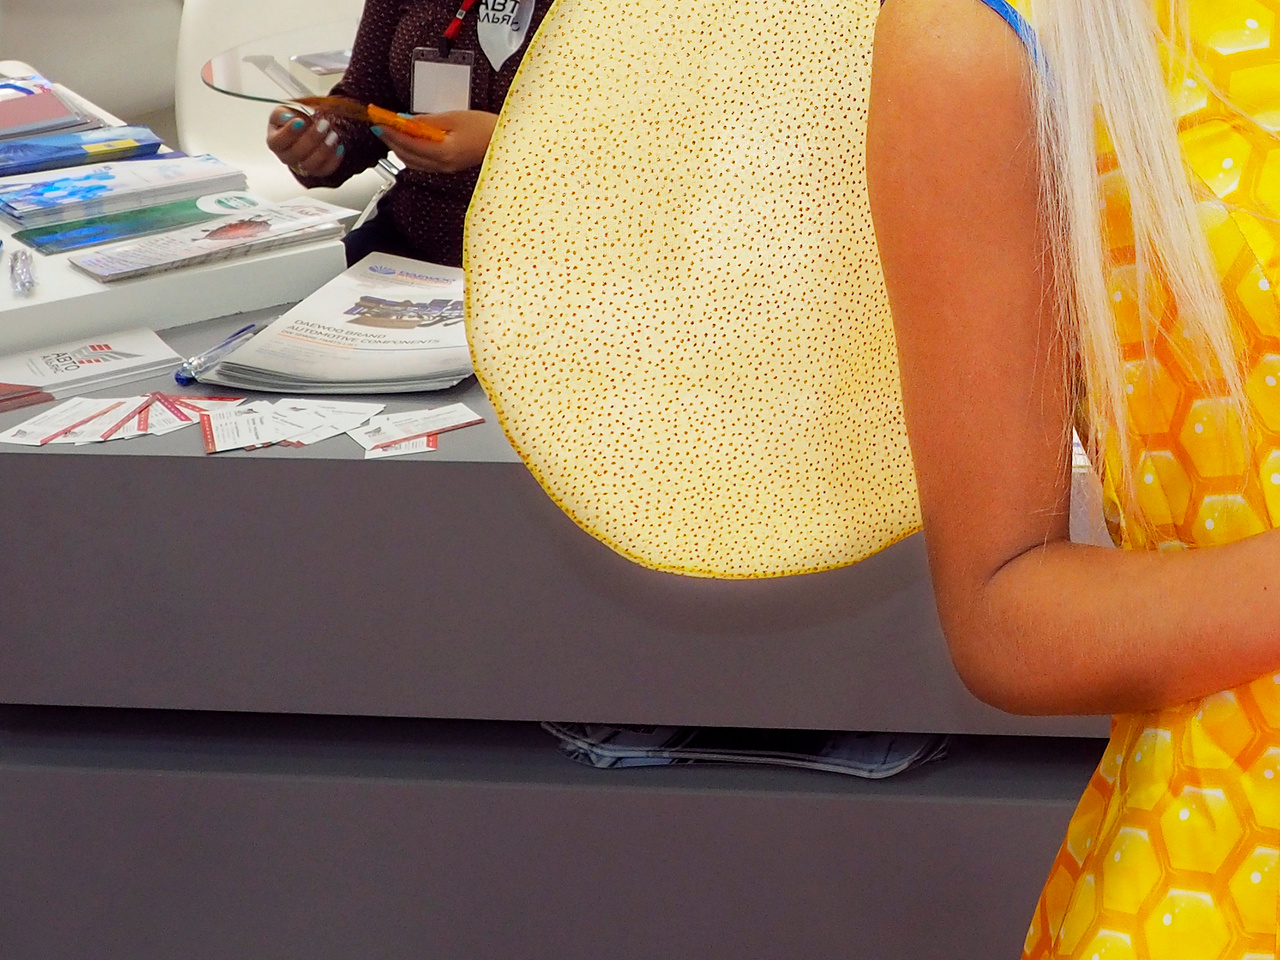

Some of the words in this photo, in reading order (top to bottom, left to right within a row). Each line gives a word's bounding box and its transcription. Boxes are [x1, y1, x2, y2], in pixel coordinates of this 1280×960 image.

[287, 325, 356, 342] AUTOMOTIVE
[294, 319, 344, 334] DAEWOO
[345, 330, 387, 339] BRAND
[51, 352, 80, 371] АВТО
